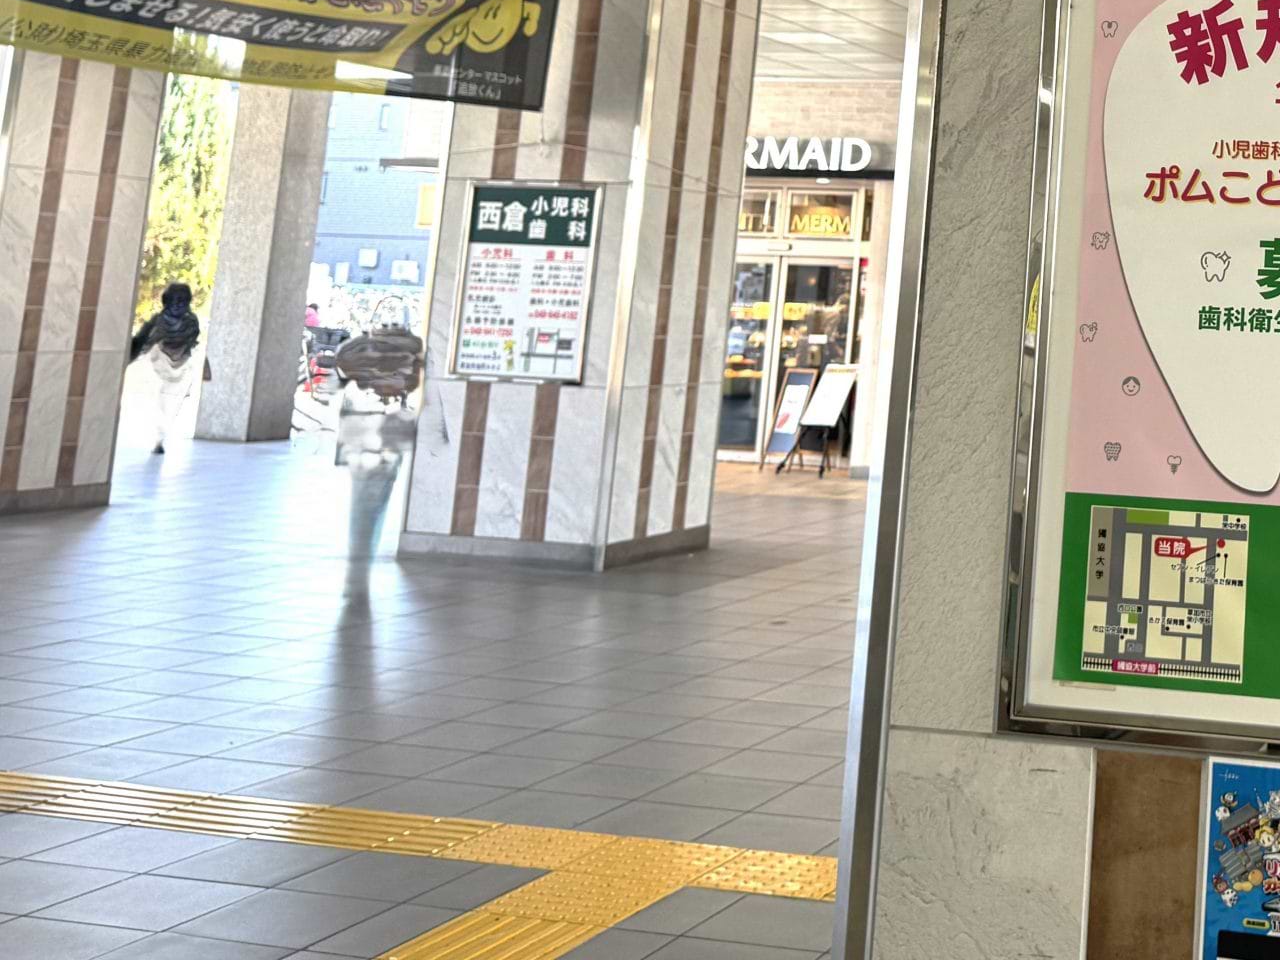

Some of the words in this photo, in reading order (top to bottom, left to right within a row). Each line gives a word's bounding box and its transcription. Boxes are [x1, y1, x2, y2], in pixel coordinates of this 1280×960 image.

[477, 200, 528, 233] 西倉
[531, 195, 590, 219] 小児科
[1158, 541, 1186, 555] 当院
